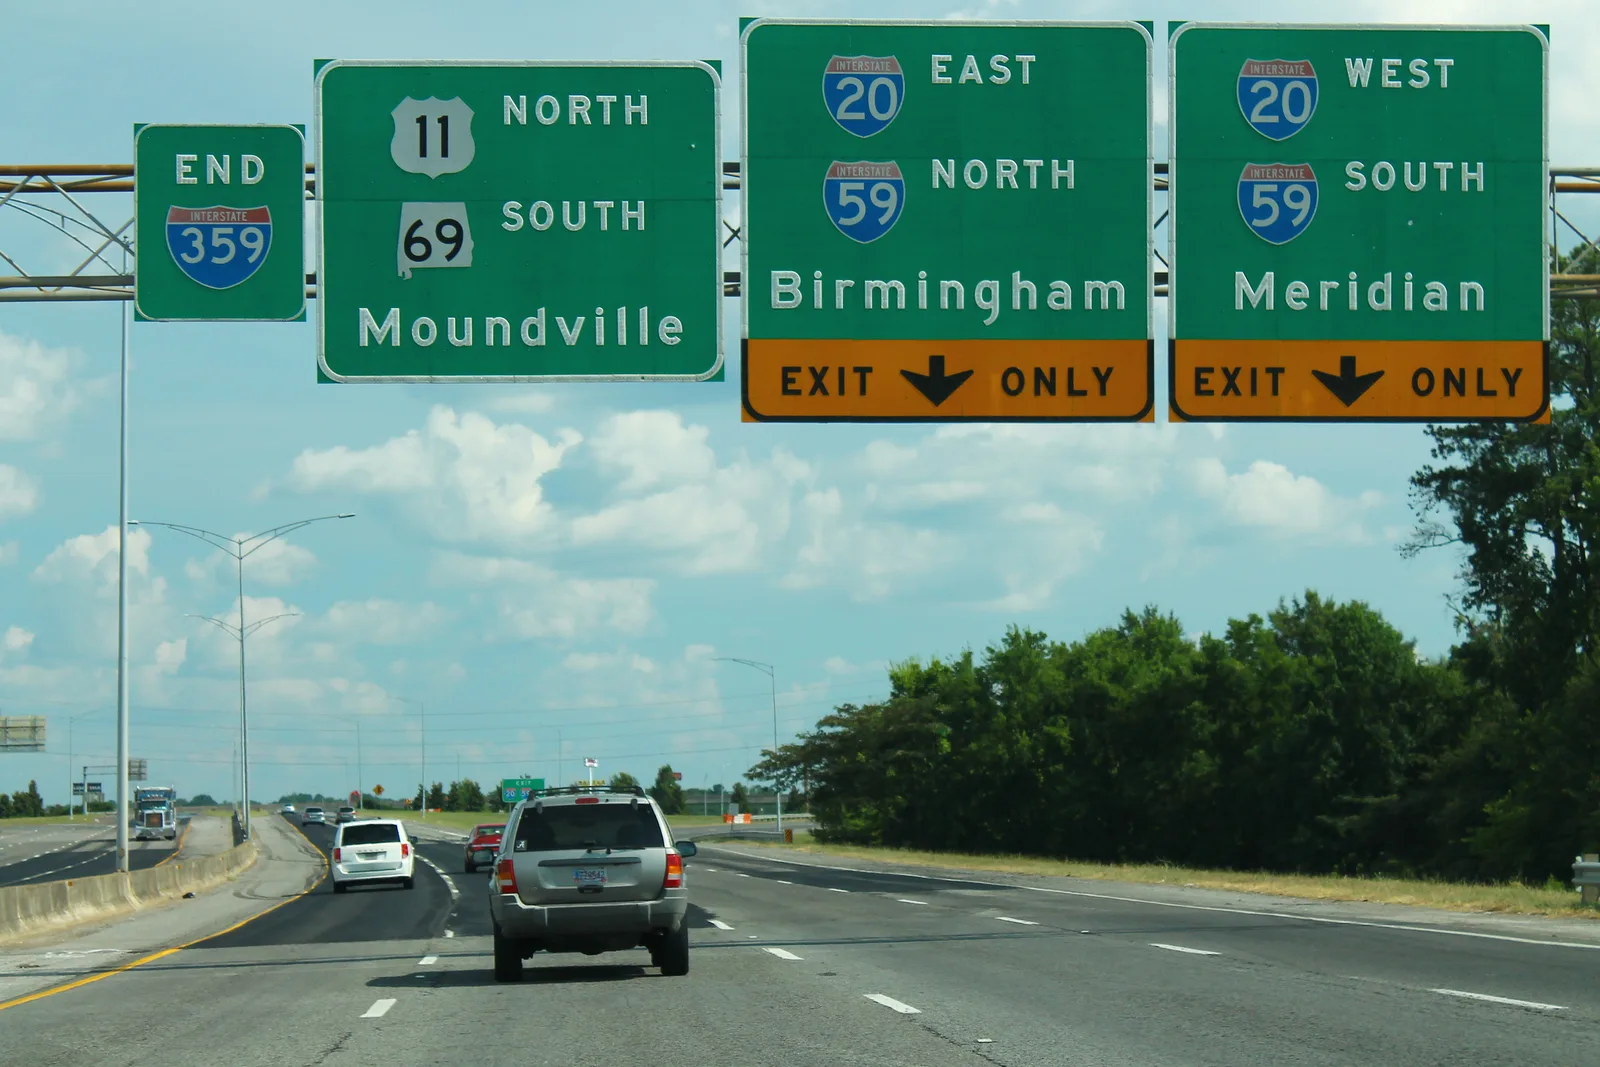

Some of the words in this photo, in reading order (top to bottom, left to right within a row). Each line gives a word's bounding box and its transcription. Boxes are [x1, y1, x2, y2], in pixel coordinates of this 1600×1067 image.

[835, 60, 891, 72] INTERSTATE
[931, 54, 1036, 84] EAST
[1250, 63, 1305, 76] INTERSTATE
[1345, 57, 1454, 88] WEST
[503, 95, 648, 125] NORTH
[836, 77, 898, 121] 20
[1250, 80, 1312, 124] 20
[415, 115, 449, 158] 11
[175, 154, 265, 185] END
[836, 165, 892, 177] INTERSTATE
[932, 159, 1075, 190] NORTH
[1250, 168, 1306, 180] INTERSTATE
[1345, 161, 1485, 192] SOUTH
[190, 211, 248, 222] INTERSTATE
[501, 200, 645, 231] SOUTH
[838, 182, 898, 226] 59
[1251, 184, 1311, 227] 59
[180, 227, 264, 265] 359
[403, 218, 464, 262] 69
[770, 270, 1125, 326] Birmingham
[1234, 271, 1485, 311] Meridian
[358, 306, 683, 347] Moundville
[781, 366, 873, 397] EXIT
[1001, 366, 1114, 397] ONLY
[1194, 367, 1285, 397] EXIT
[1411, 367, 1523, 397] ONLY
